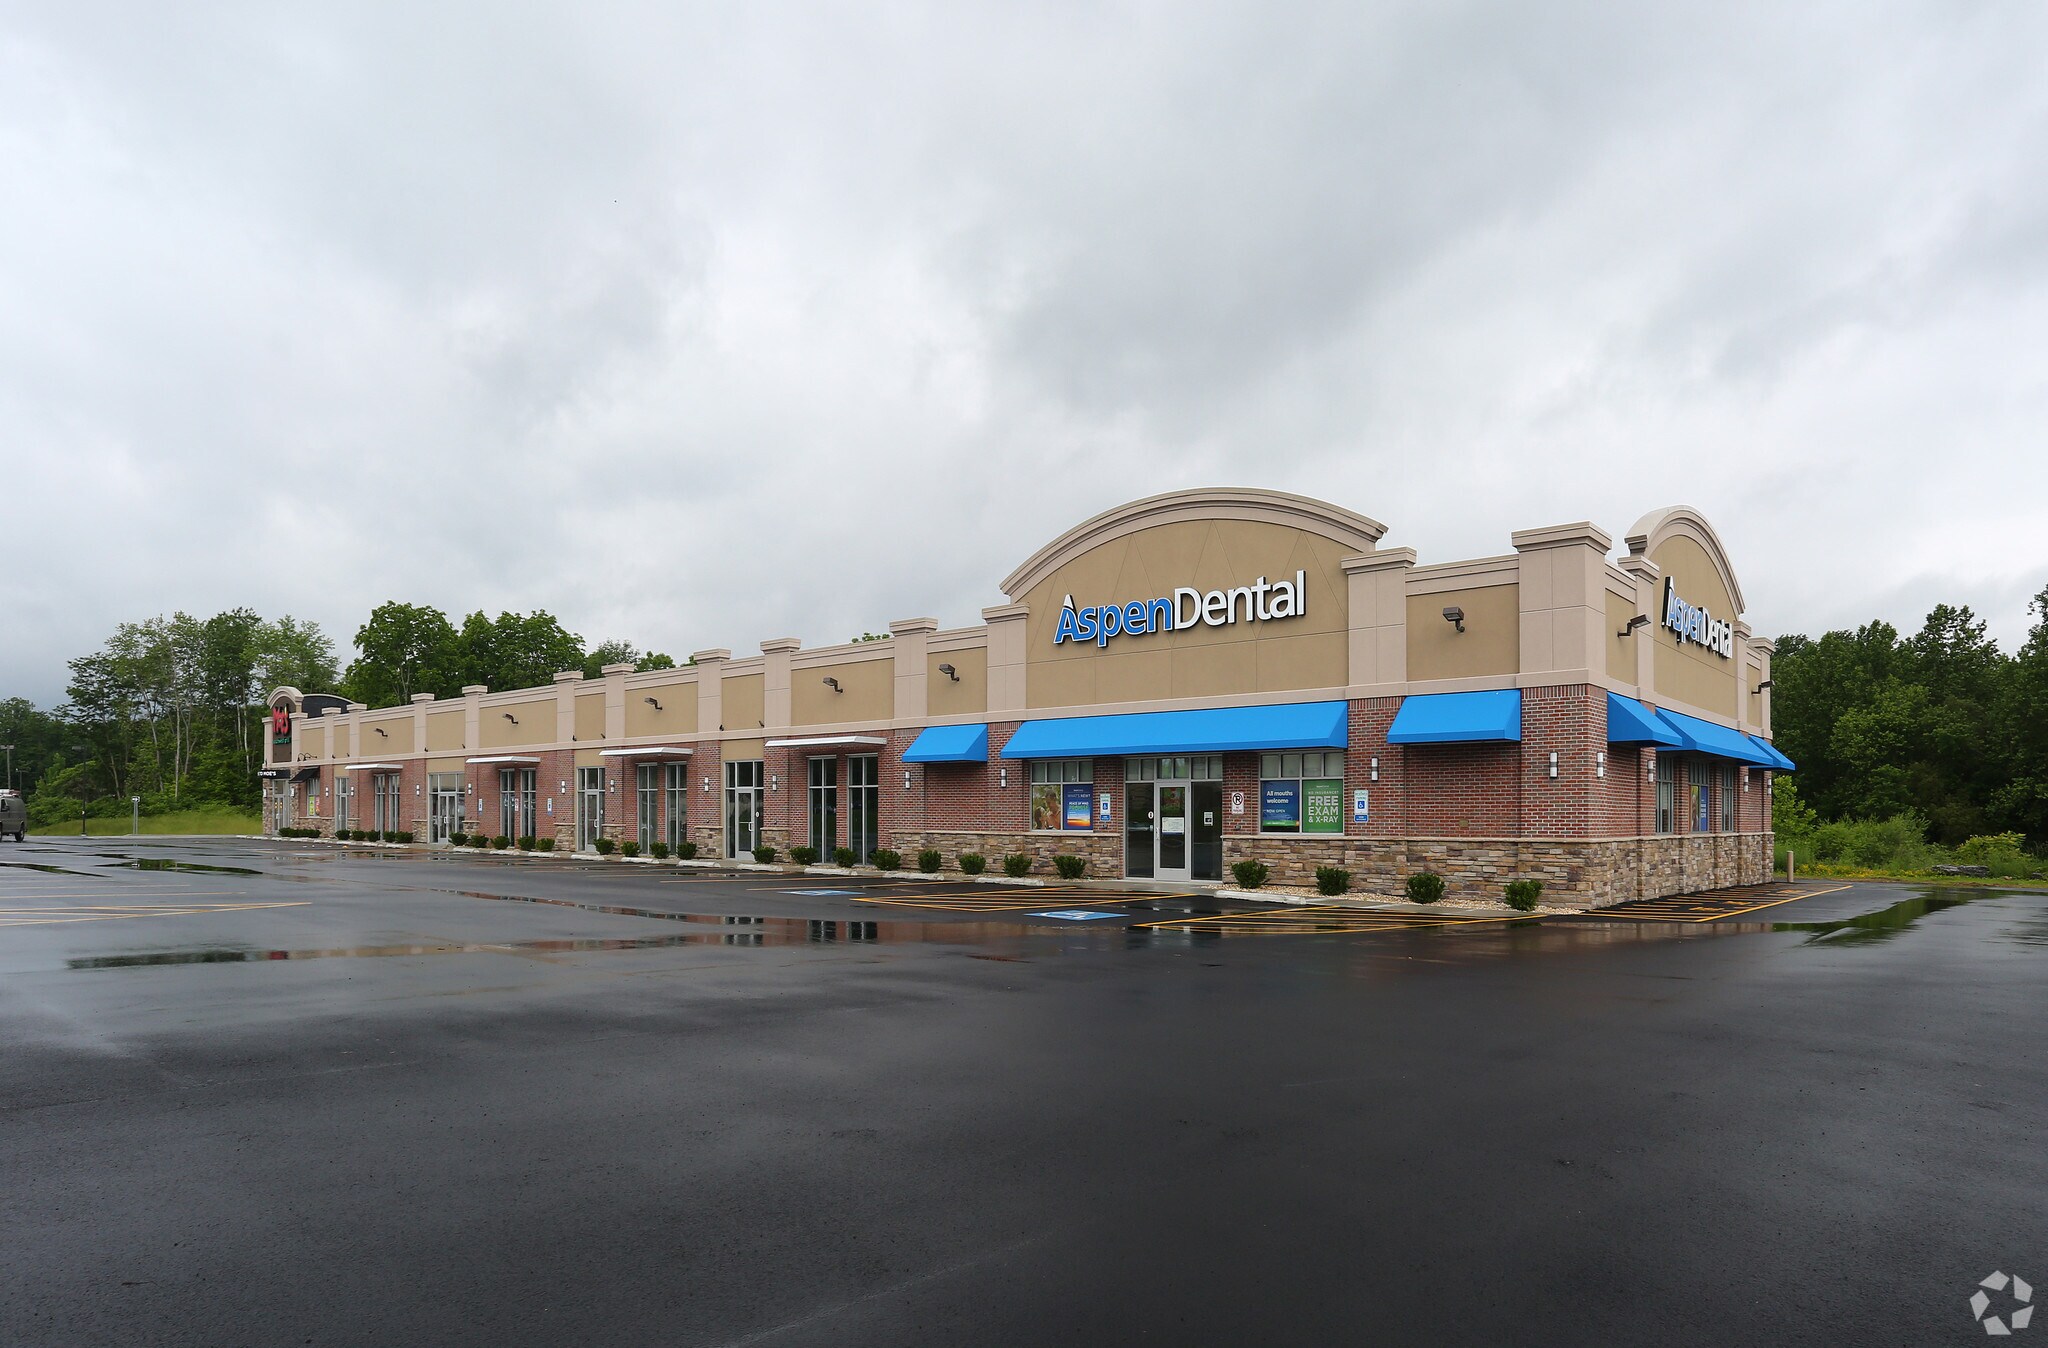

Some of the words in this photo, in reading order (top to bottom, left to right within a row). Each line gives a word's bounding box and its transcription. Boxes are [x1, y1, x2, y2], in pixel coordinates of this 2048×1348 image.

[1053, 569, 1306, 648] AspenDental
[1308, 796, 1339, 806] FREE
[1308, 806, 1339, 816] EXAM
